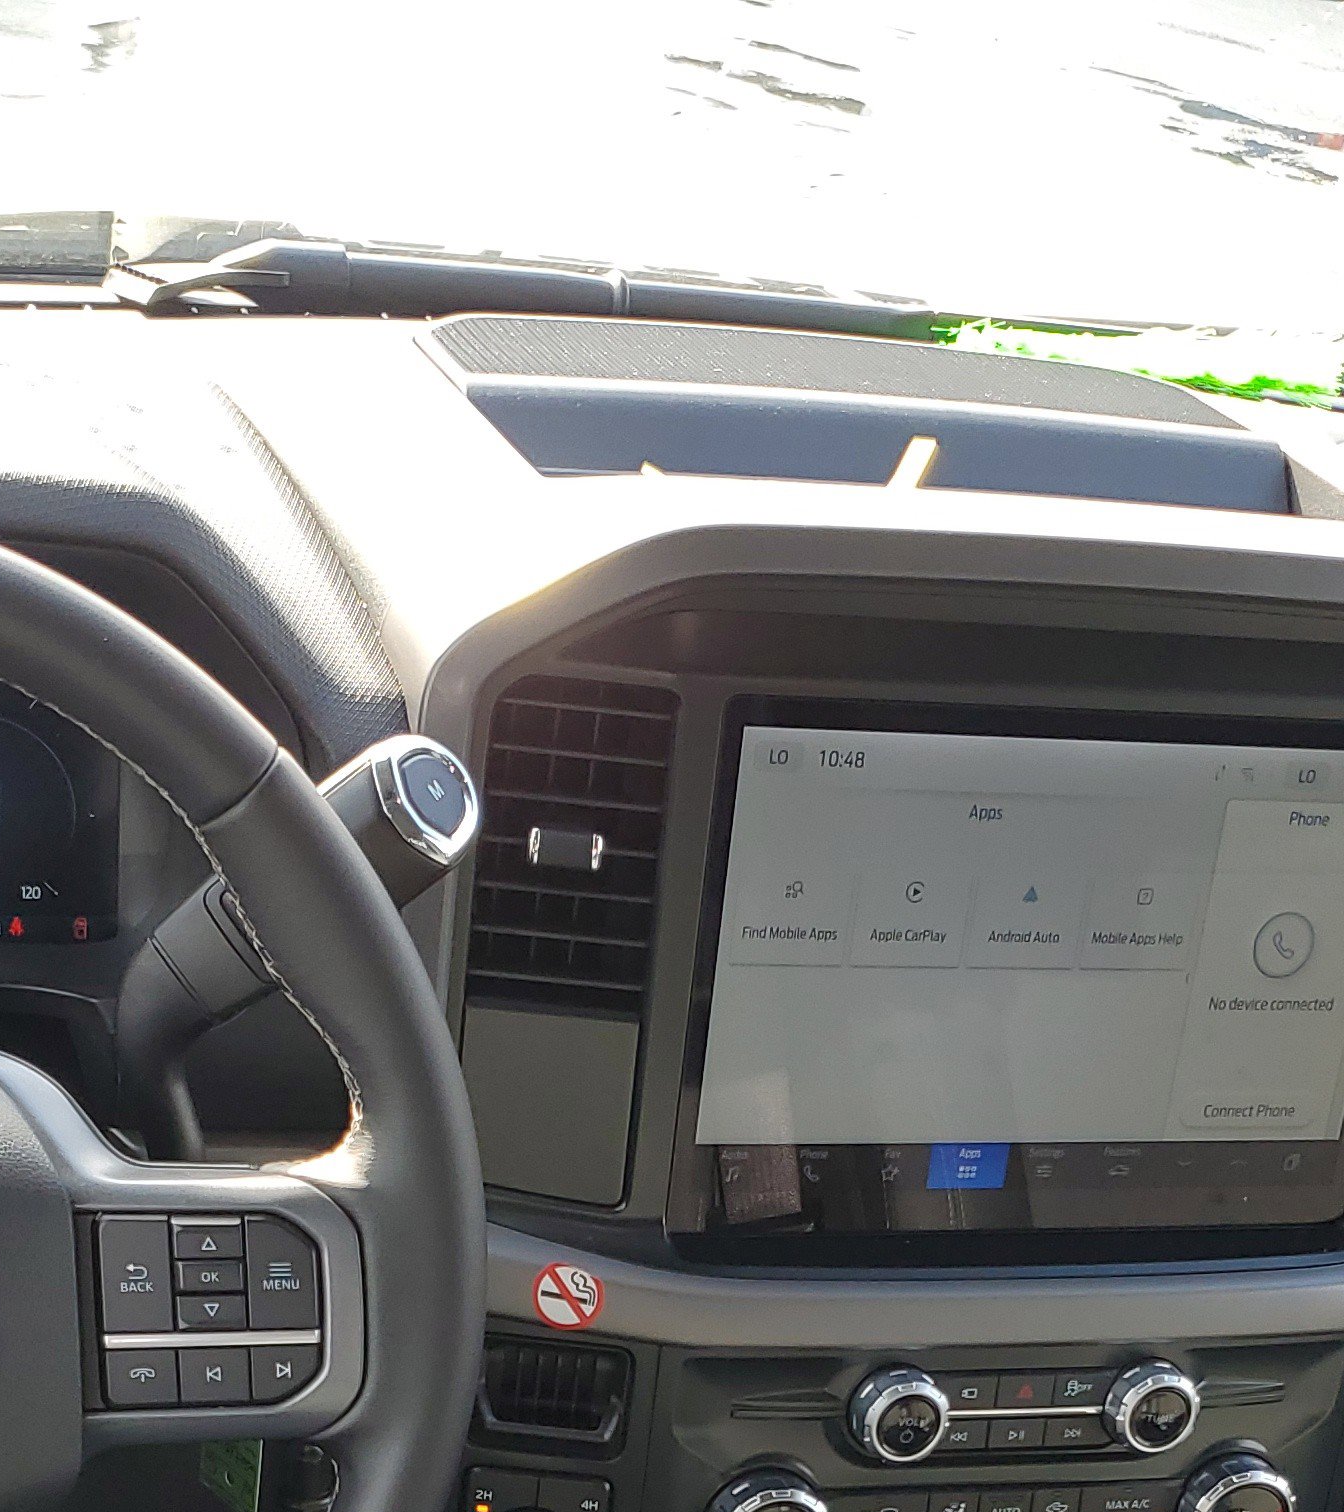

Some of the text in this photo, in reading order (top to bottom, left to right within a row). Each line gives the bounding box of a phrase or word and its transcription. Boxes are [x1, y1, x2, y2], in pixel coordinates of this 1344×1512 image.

[768, 749, 866, 769] LO 10:48
[1298, 769, 1316, 784] LO
[427, 779, 445, 801] M
[968, 804, 1003, 822] Apps
[1289, 811, 1330, 827] Phone
[21, 886, 42, 900] 120
[742, 926, 838, 942] Find Mobile Apps
[870, 928, 947, 944] Apple CarPlay
[987, 930, 1060, 943] Android Auto
[1091, 931, 1184, 947] Mobile Apps Help
[1208, 996, 1335, 1012] No device connected
[1203, 1104, 1295, 1118] Connect Phone
[958, 1148, 981, 1159] Apps
[201, 1272, 220, 1283] OK
[120, 1281, 154, 1293] BACK
[263, 1279, 300, 1291] MENU
[475, 1490, 492, 1501] 2H
[580, 1500, 598, 1511] 4H
[1105, 1499, 1150, 1509] MAX A/C
